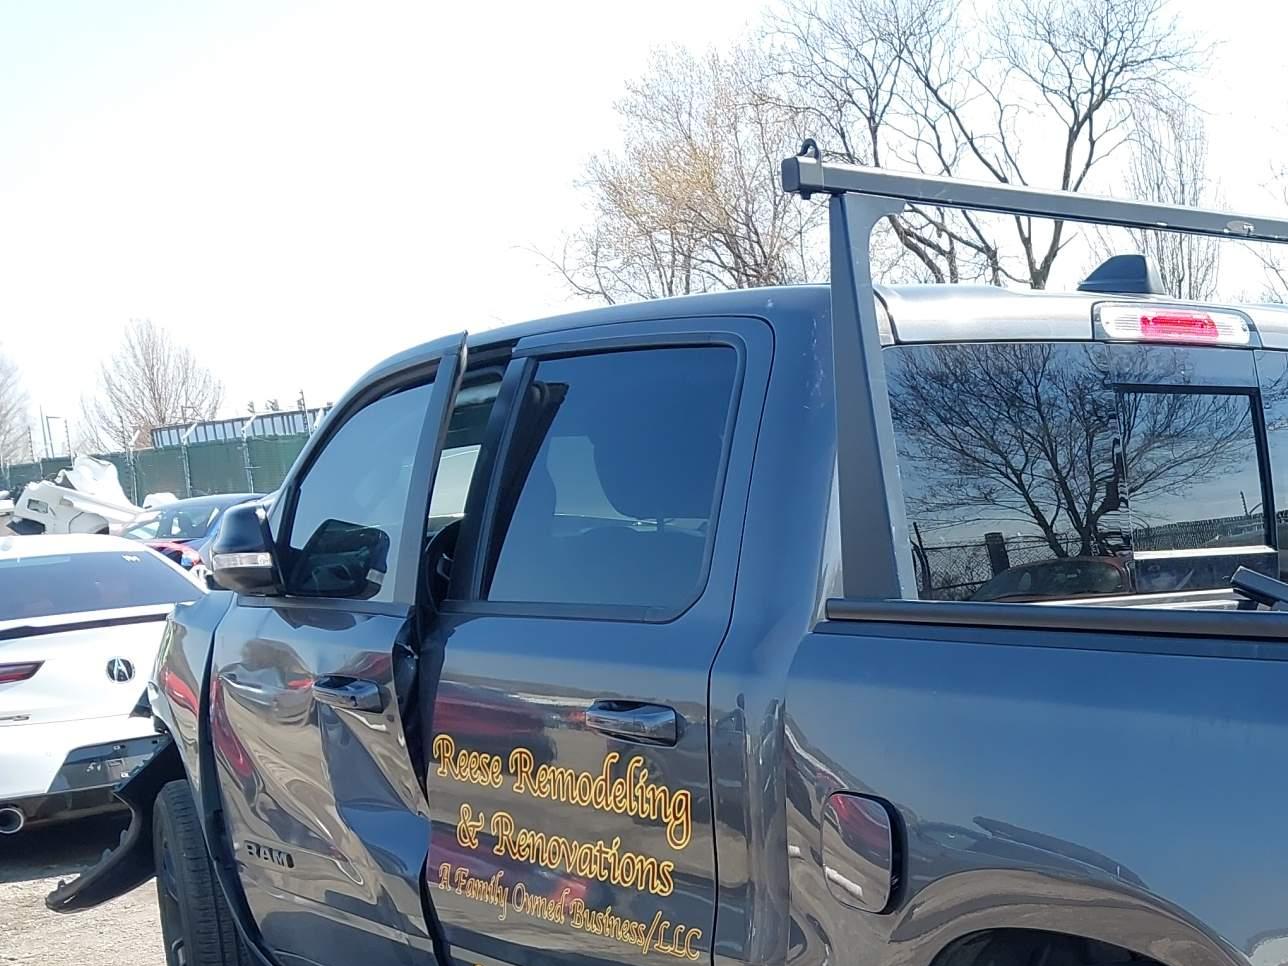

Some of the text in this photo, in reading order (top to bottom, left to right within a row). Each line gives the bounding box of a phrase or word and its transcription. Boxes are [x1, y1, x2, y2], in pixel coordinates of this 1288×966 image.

[433, 734, 692, 849] Reese Remodeling
[243, 839, 295, 868] RAM
[456, 803, 674, 897] & Renovations
[438, 863, 703, 960] A Family Owned Business/LLC
